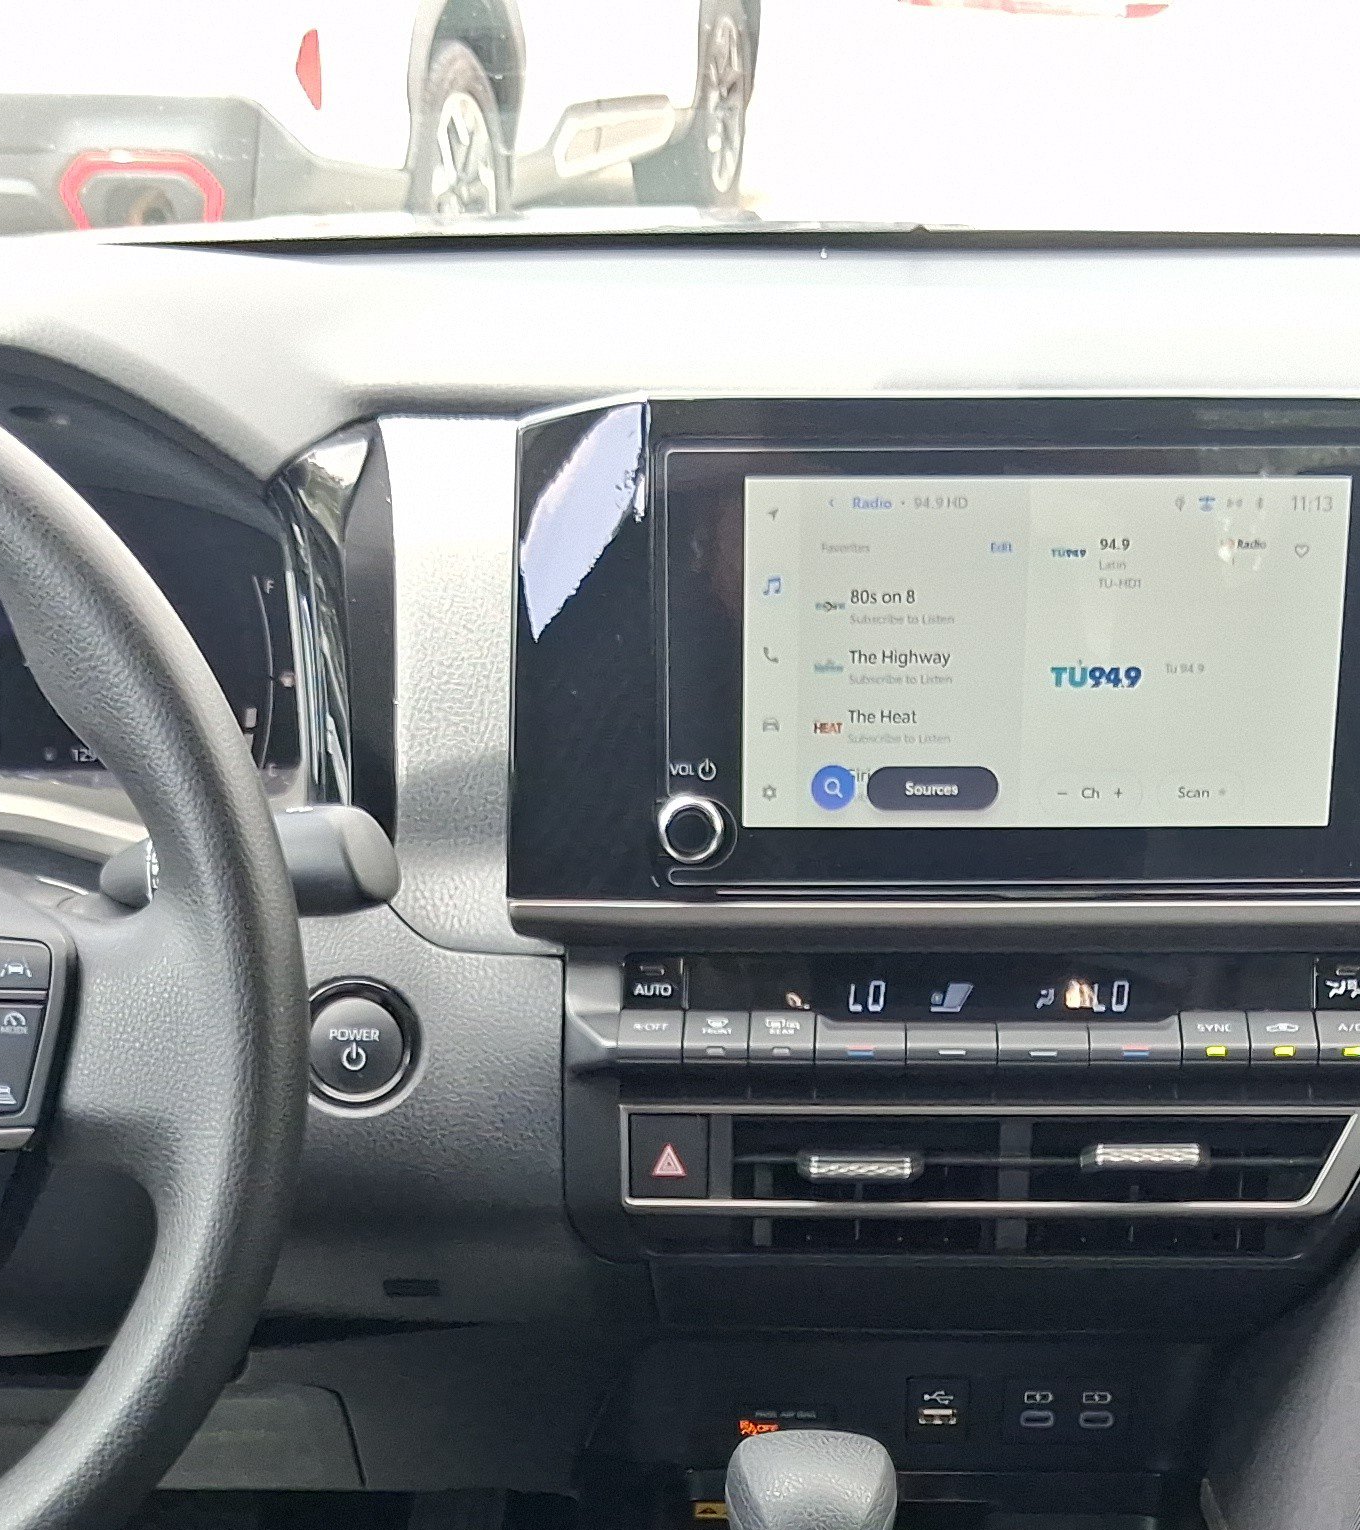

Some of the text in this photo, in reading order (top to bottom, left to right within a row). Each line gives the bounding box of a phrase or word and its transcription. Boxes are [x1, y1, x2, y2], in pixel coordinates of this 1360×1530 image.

[852, 497, 893, 509] Radio
[1291, 496, 1334, 512] 11:13
[990, 542, 1013, 553] Edit
[1099, 537, 1130, 551] 94.9
[1098, 560, 1127, 571] Latin
[850, 589, 916, 604] 80s on 8
[849, 614, 955, 625] Subscribe to Listen
[849, 649, 951, 668] The Highway
[849, 674, 953, 685] Subscribe to Listen
[848, 709, 918, 724] The Heat
[813, 722, 843, 734] HEAT
[847, 734, 951, 744] Subscribe to Listen
[669, 763, 695, 776] VOL
[904, 781, 959, 797] Sources
[1081, 786, 1100, 799] Ch
[1178, 786, 1210, 798] Scan
[633, 983, 673, 997] AUTO
[848, 979, 887, 1013] LO
[1091, 979, 1130, 1013] LO
[1196, 1022, 1233, 1033] SYNC
[328, 1027, 381, 1043] POWER
